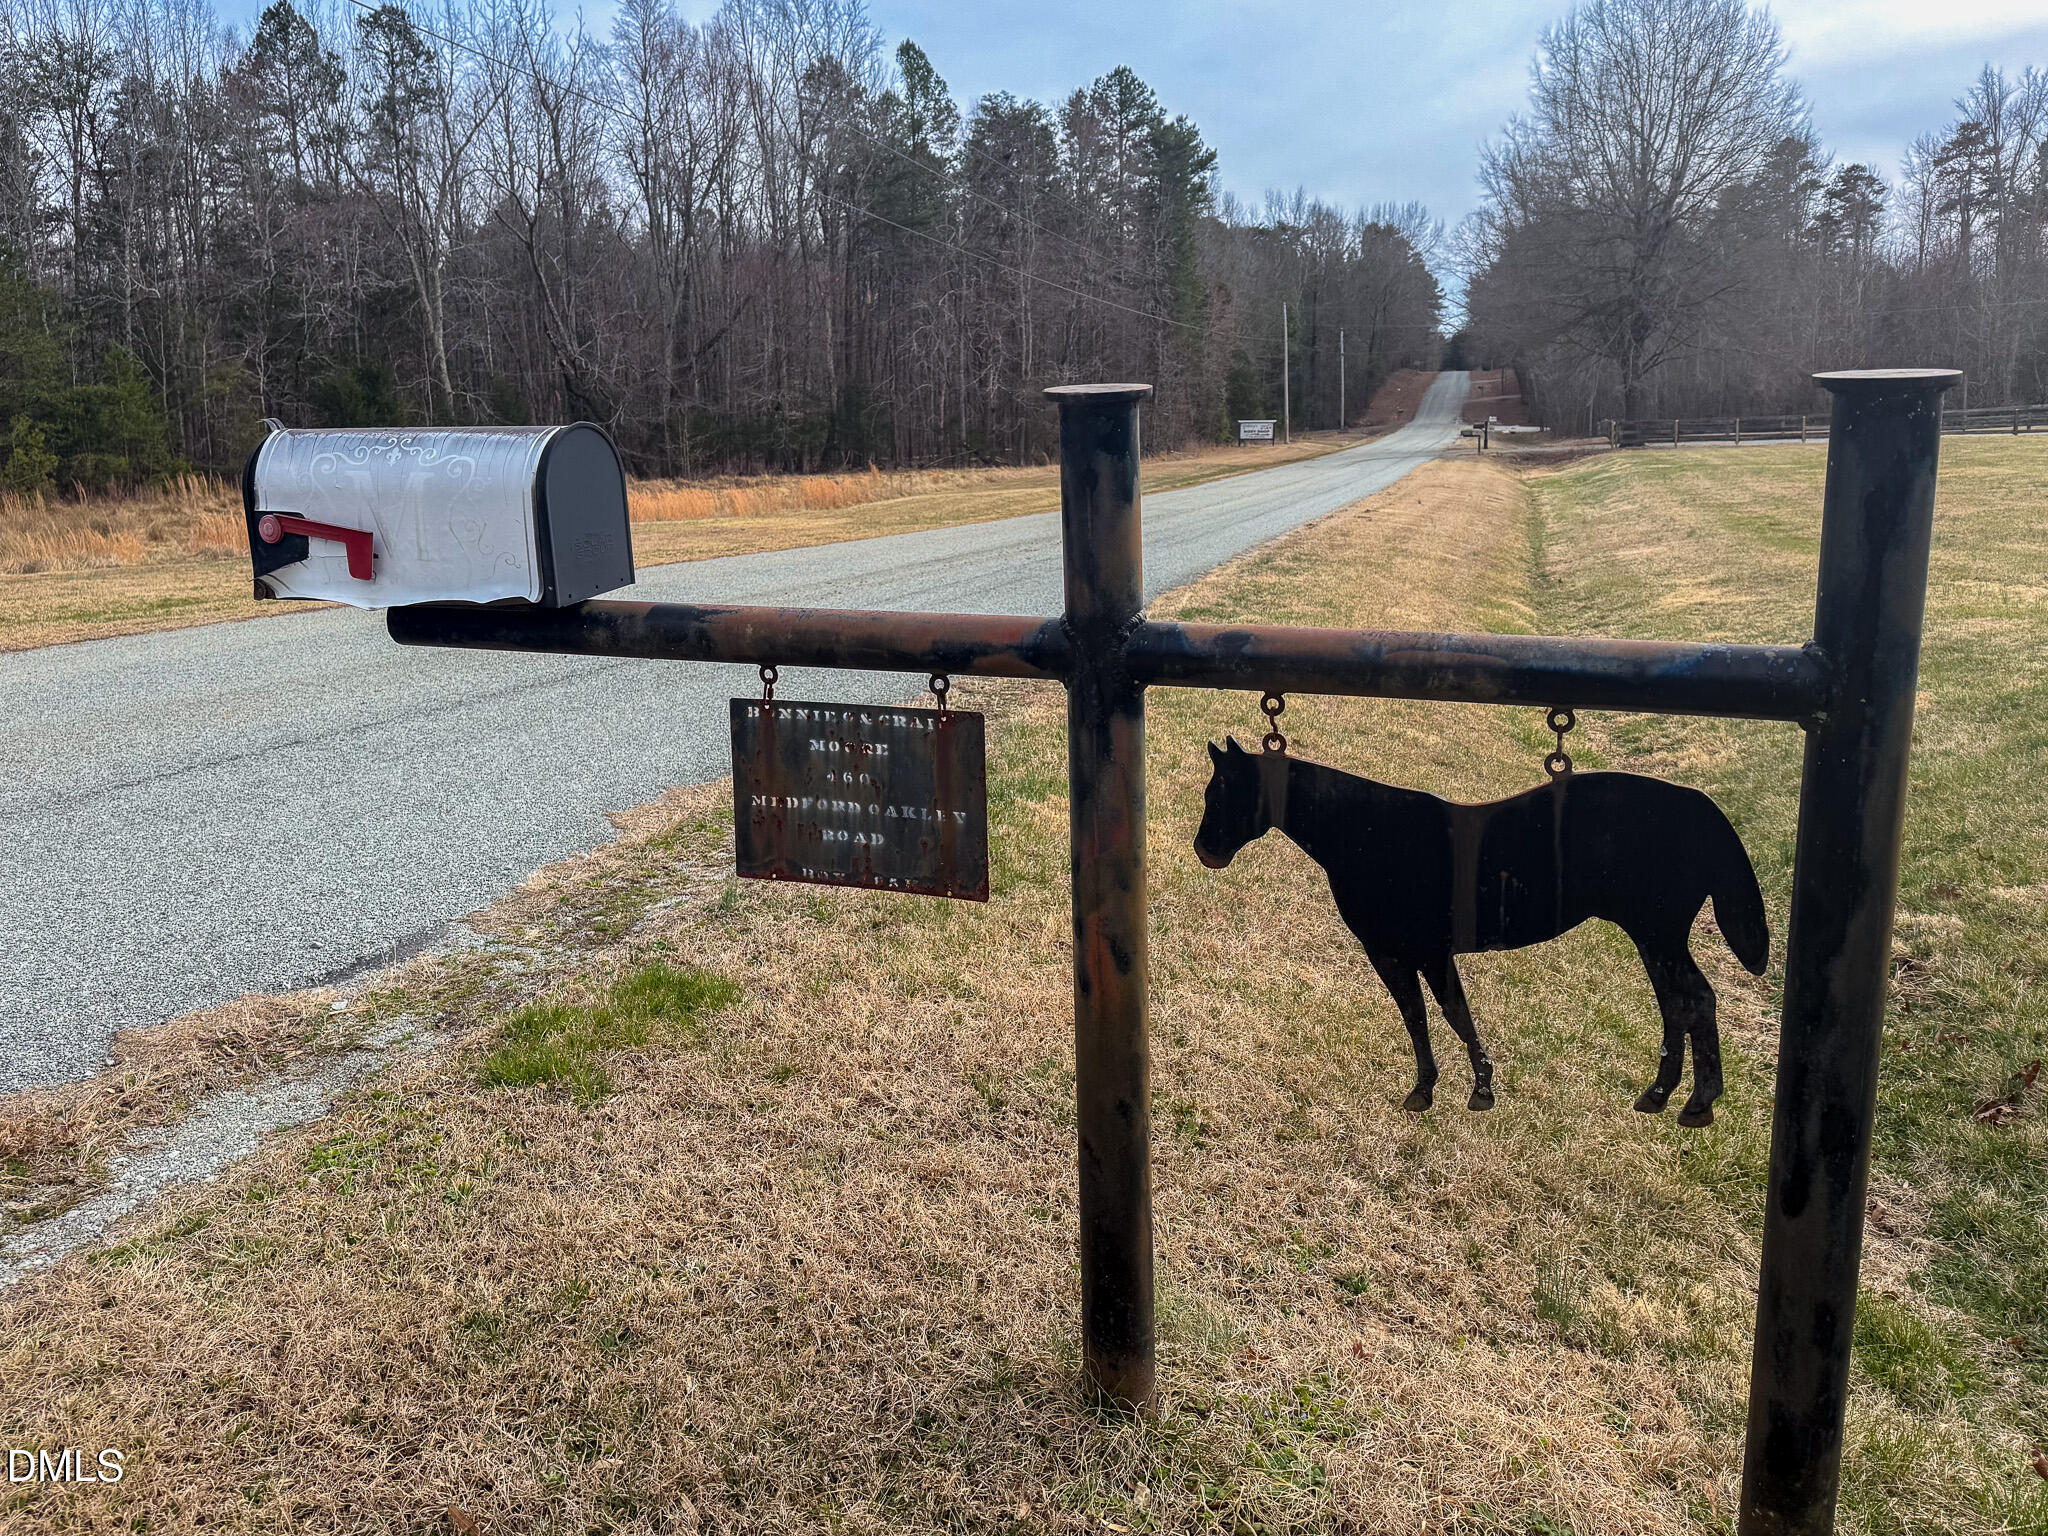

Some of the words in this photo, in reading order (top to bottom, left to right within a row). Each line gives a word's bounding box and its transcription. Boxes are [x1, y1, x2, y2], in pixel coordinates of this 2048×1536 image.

[747, 705, 837, 723] BNNIE
[859, 712, 873, 725] &
[878, 713, 954, 730] CRAI
[809, 739, 889, 756] MOORE
[751, 795, 862, 815] MEDFORD
[822, 828, 885, 845] ROAD
